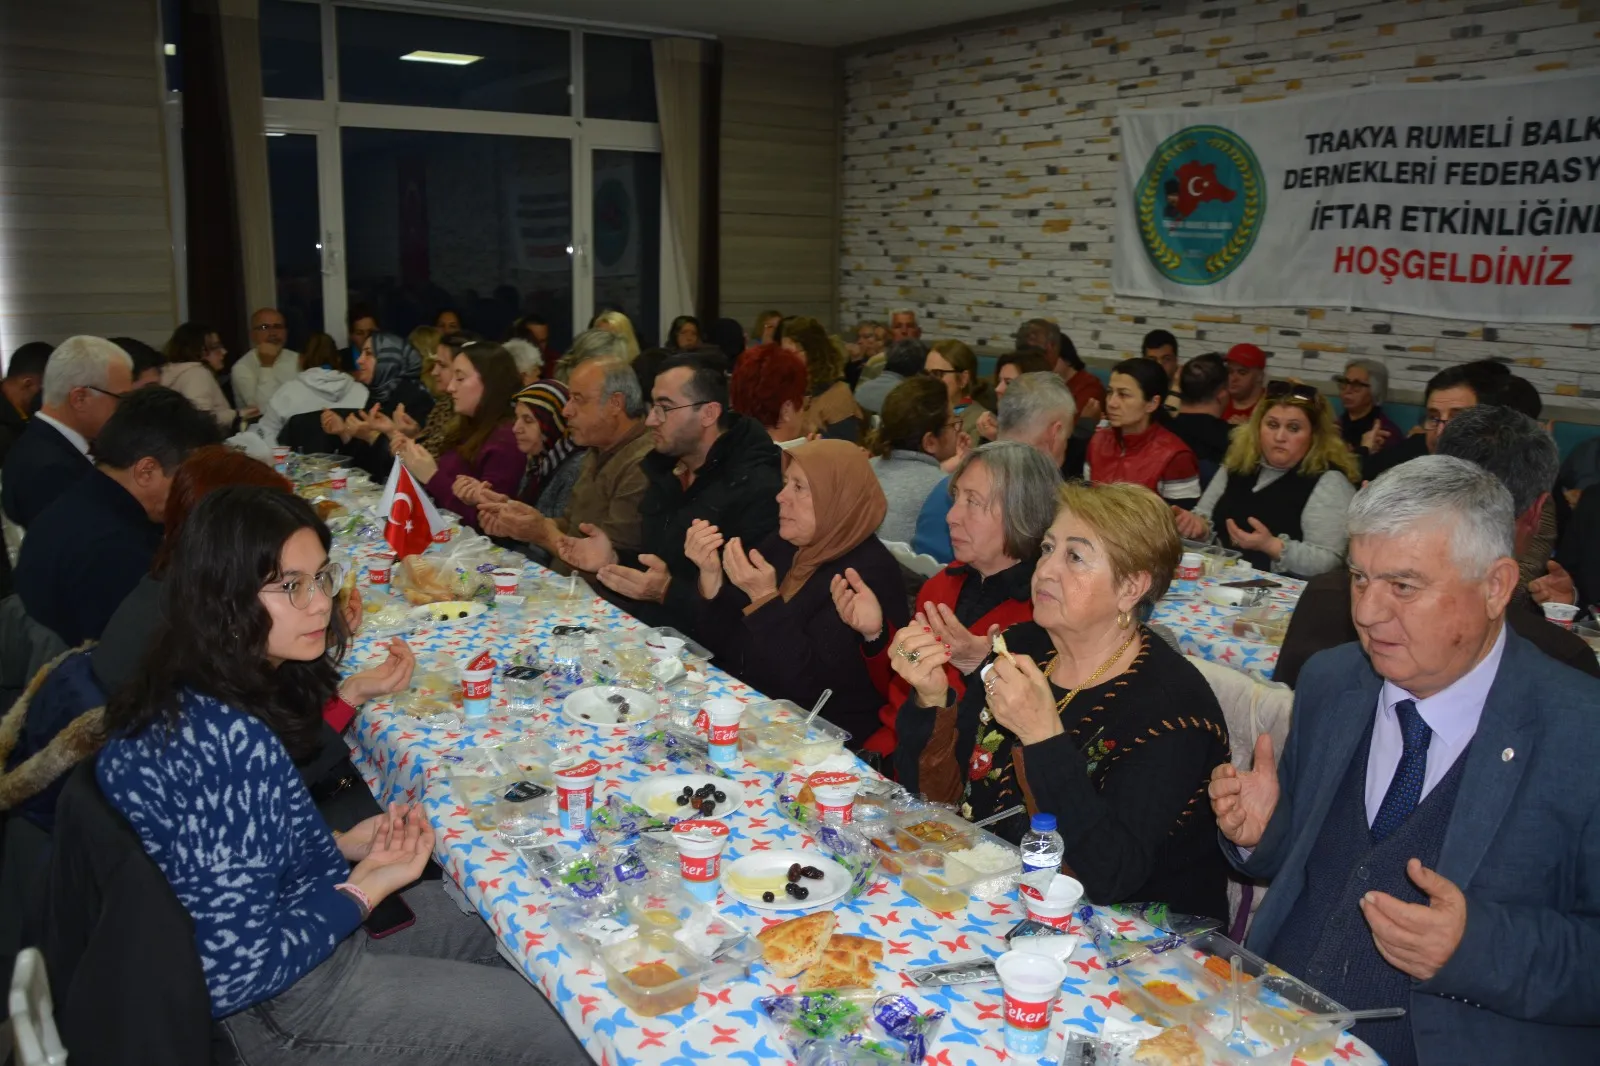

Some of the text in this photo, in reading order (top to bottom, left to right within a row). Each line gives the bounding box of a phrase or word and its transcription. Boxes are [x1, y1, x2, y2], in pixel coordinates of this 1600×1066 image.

[1305, 125, 1398, 155] TRAKYA
[1405, 116, 1515, 149] RUMELİ
[1283, 156, 1438, 190] DERNEKLERİ
[1310, 201, 1392, 231] İFTAR
[1333, 245, 1573, 285] HOŞGELDİNİZ
